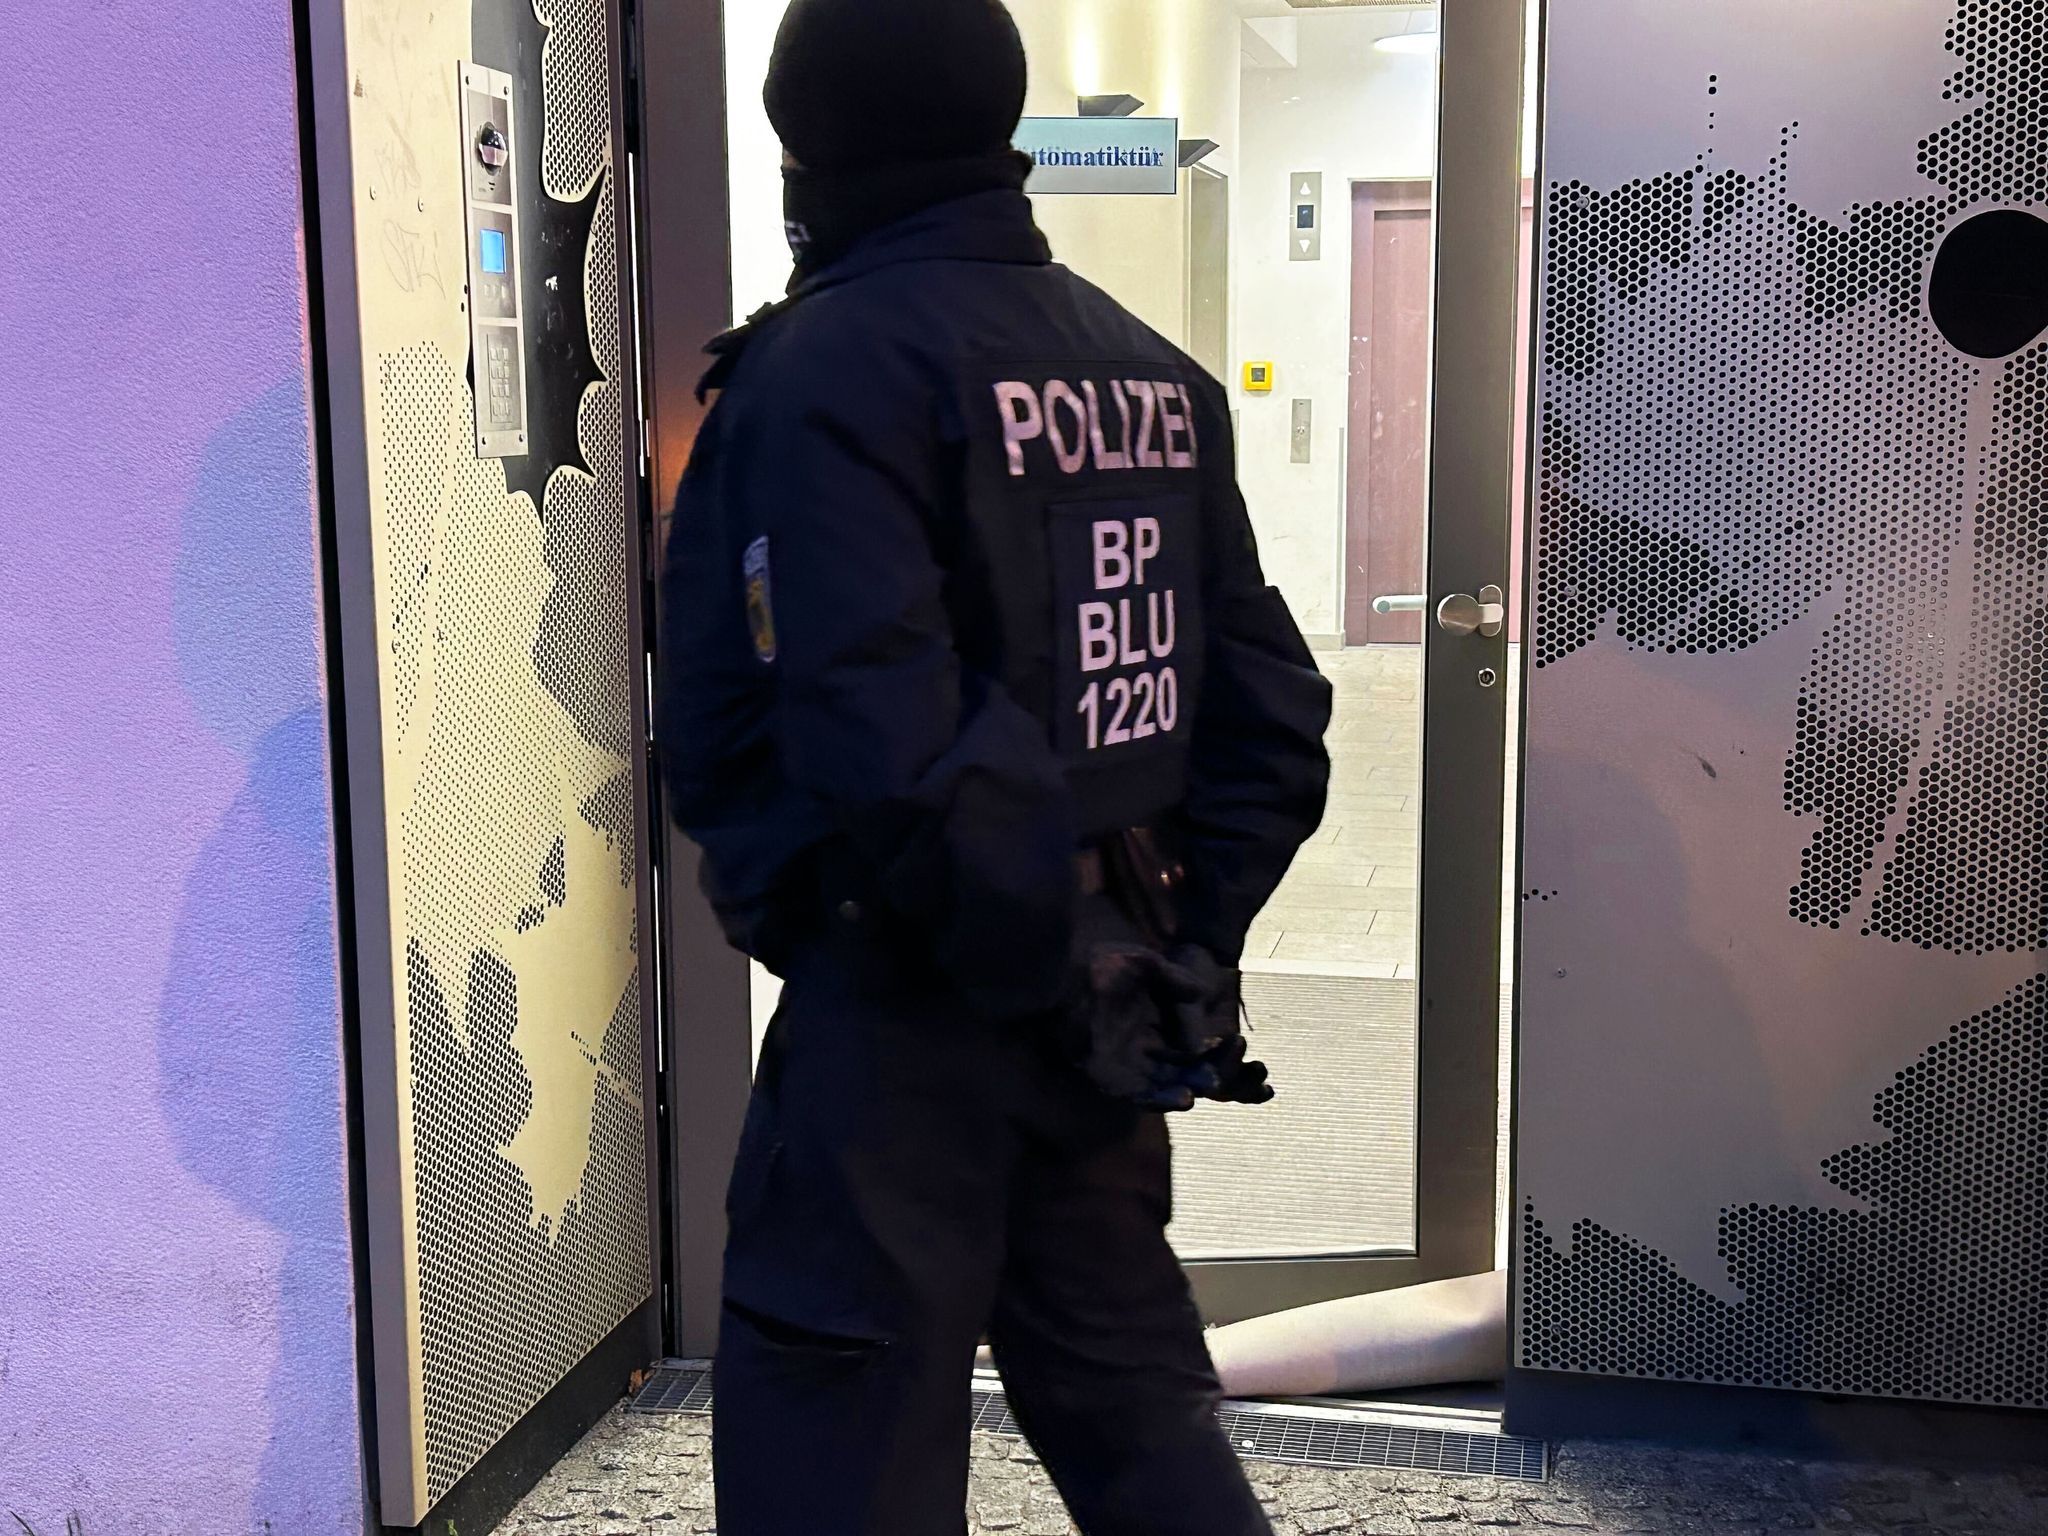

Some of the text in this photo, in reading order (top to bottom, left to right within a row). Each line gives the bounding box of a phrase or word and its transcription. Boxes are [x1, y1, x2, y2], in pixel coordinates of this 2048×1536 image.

[993, 379, 1198, 476] POLIZEI
[1092, 517, 1161, 590] BP
[1078, 590, 1175, 672] BLU
[1077, 667, 1178, 749] 1220
